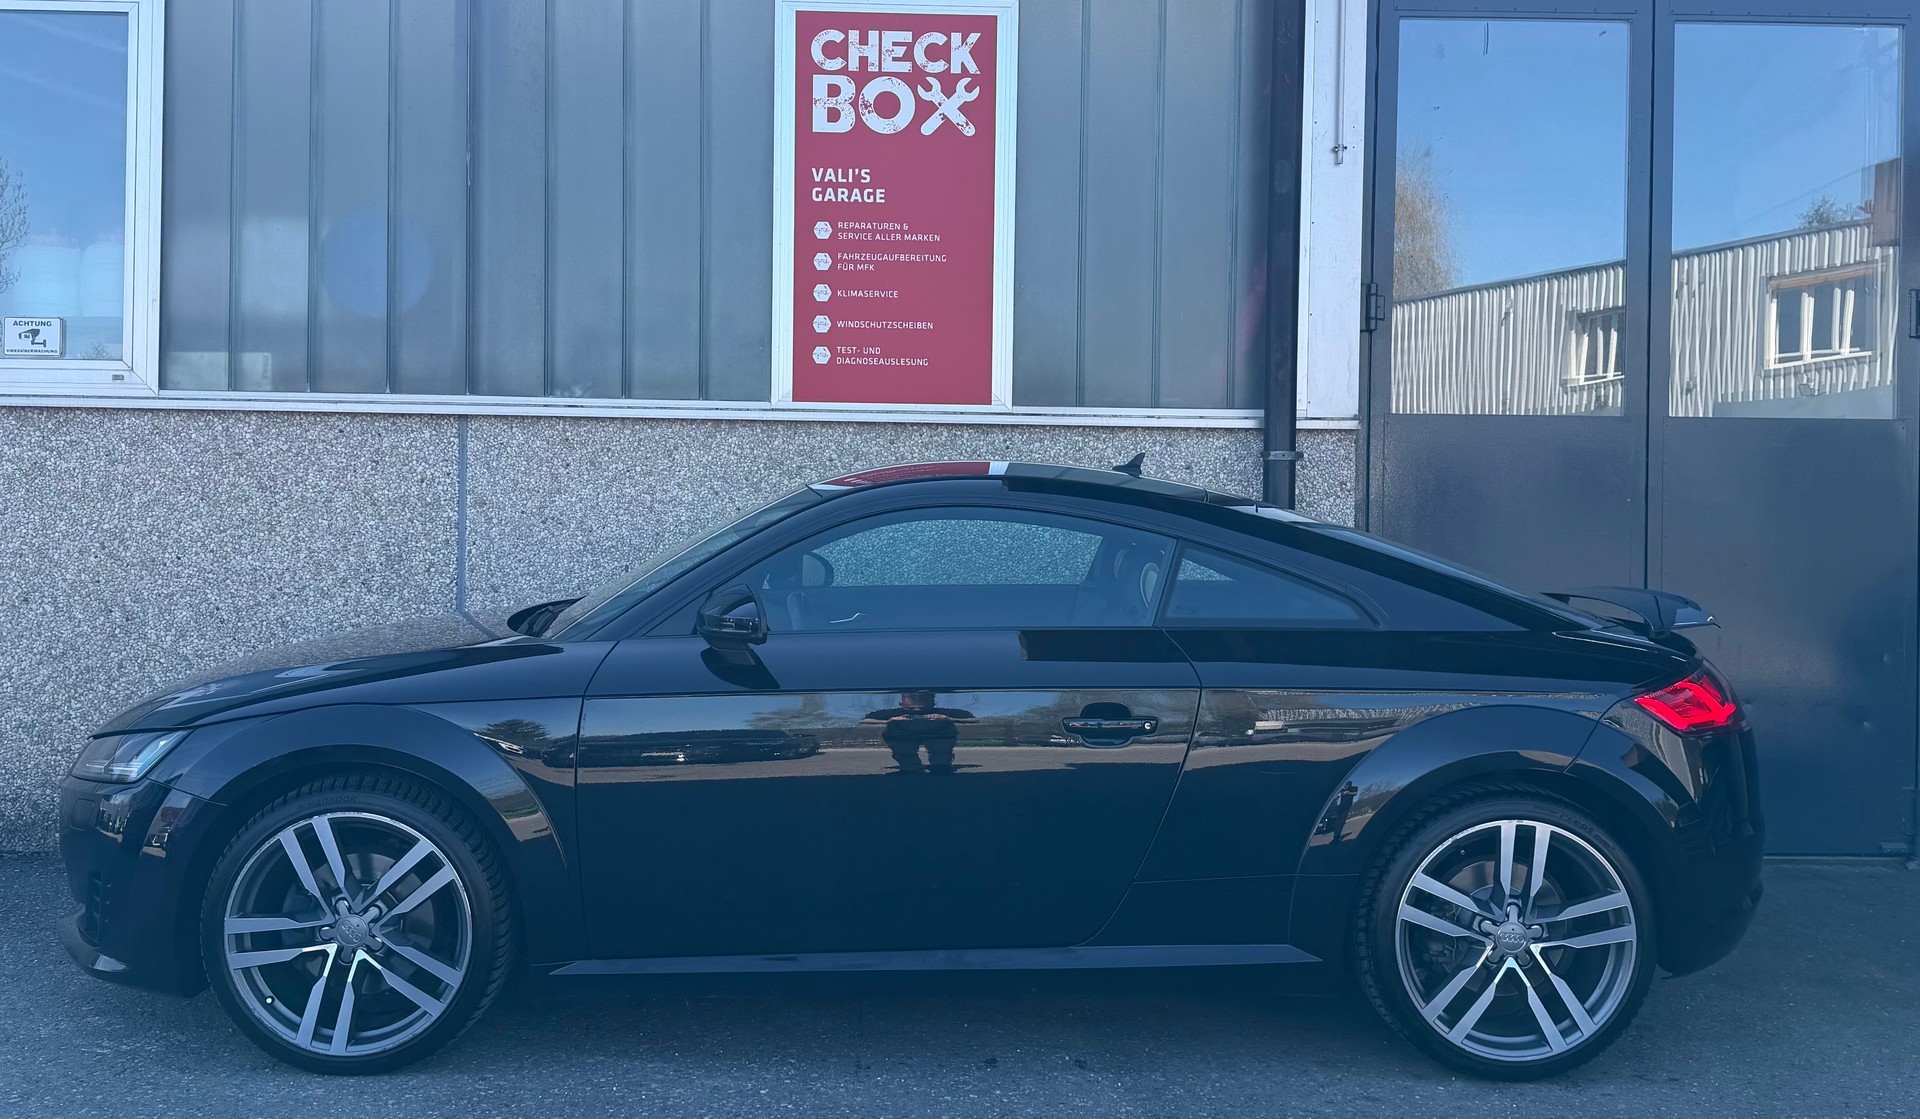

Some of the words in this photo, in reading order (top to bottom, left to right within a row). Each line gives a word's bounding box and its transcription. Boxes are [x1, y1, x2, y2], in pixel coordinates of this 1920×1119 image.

[811, 29, 981, 74] CHECK
[812, 74, 980, 137] BOX
[811, 167, 871, 183] VALI'S
[811, 187, 886, 203] GARAGE
[837, 222, 901, 230] REPARATUREN
[903, 223, 909, 231] &
[837, 232, 873, 241] SERVICE
[875, 233, 902, 241] ALLER
[904, 233, 941, 242] MARKEN
[837, 253, 947, 262] FAHRZEUGAUFBEREITUNG
[837, 262, 855, 271] FÜR
[856, 263, 875, 272] MFK
[837, 290, 898, 298] KLIMASERVICE
[836, 320, 934, 329] WINDSCHUTZSCHEIBEN
[836, 346, 861, 354] TEST-
[862, 347, 881, 355] UND
[836, 357, 929, 366] DIAGNOSEAUSLESUNG
